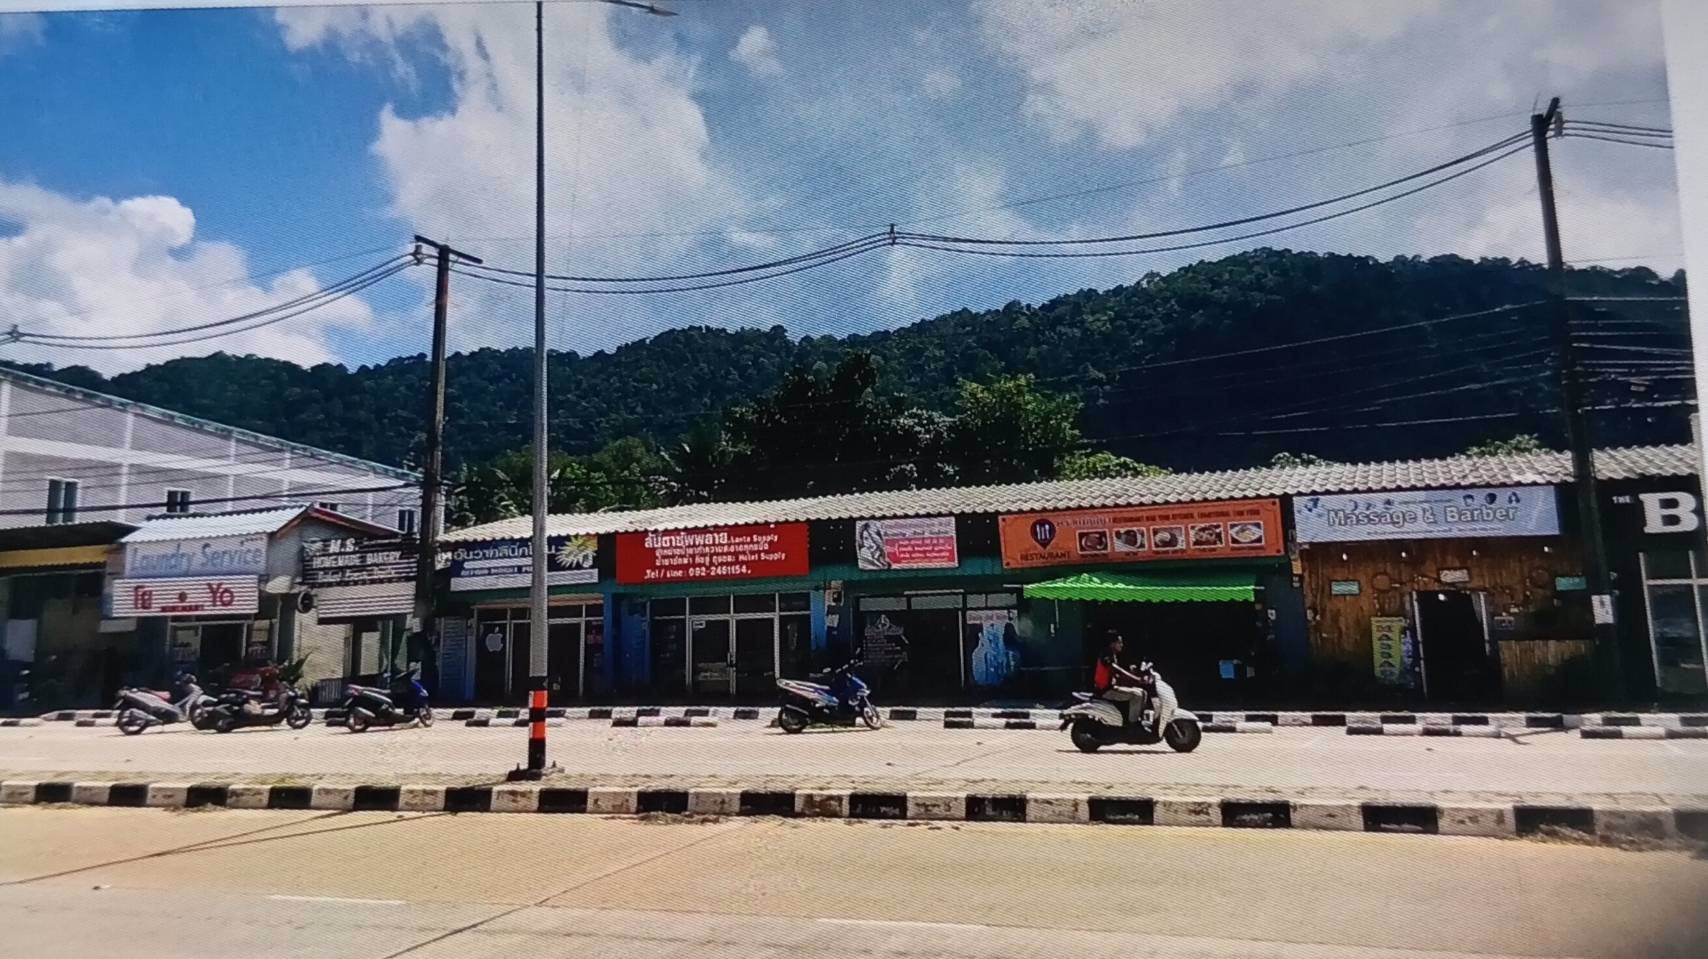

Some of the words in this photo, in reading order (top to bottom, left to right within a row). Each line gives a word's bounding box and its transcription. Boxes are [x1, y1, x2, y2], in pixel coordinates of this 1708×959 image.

[1612, 495, 1633, 504] THE
[1327, 508, 1418, 529] Massage
[1421, 506, 1437, 525] &
[1444, 503, 1520, 525] Barber
[131, 543, 194, 575] Laundry
[200, 542, 263, 567] Service
[313, 554, 361, 568] HOMEMADE
[365, 551, 402, 564] BAKERY
[1020, 550, 1071, 562] RESTAURANT
[206, 582, 235, 608] Yo
